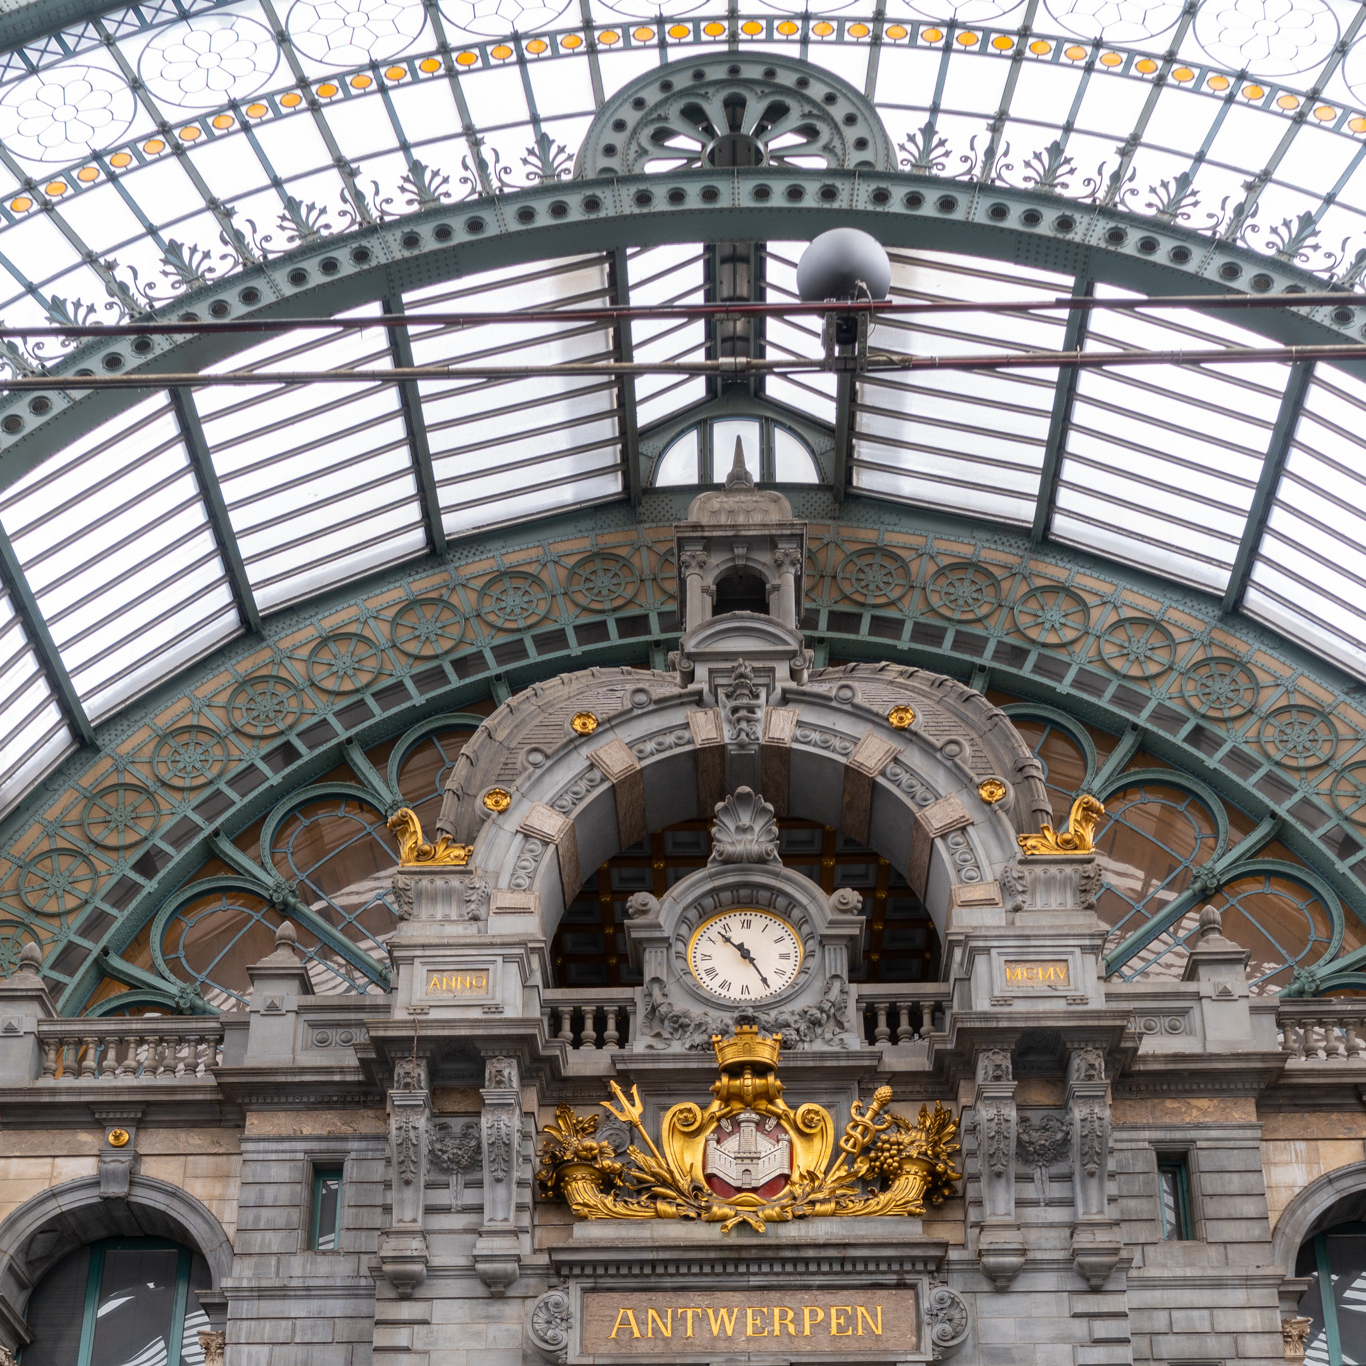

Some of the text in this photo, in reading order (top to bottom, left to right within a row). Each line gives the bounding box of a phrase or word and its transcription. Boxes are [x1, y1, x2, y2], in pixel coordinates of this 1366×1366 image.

[1005, 966, 1068, 981] MCMV
[429, 975, 487, 990] ANNO
[608, 1305, 884, 1339] ANTWERPEN
